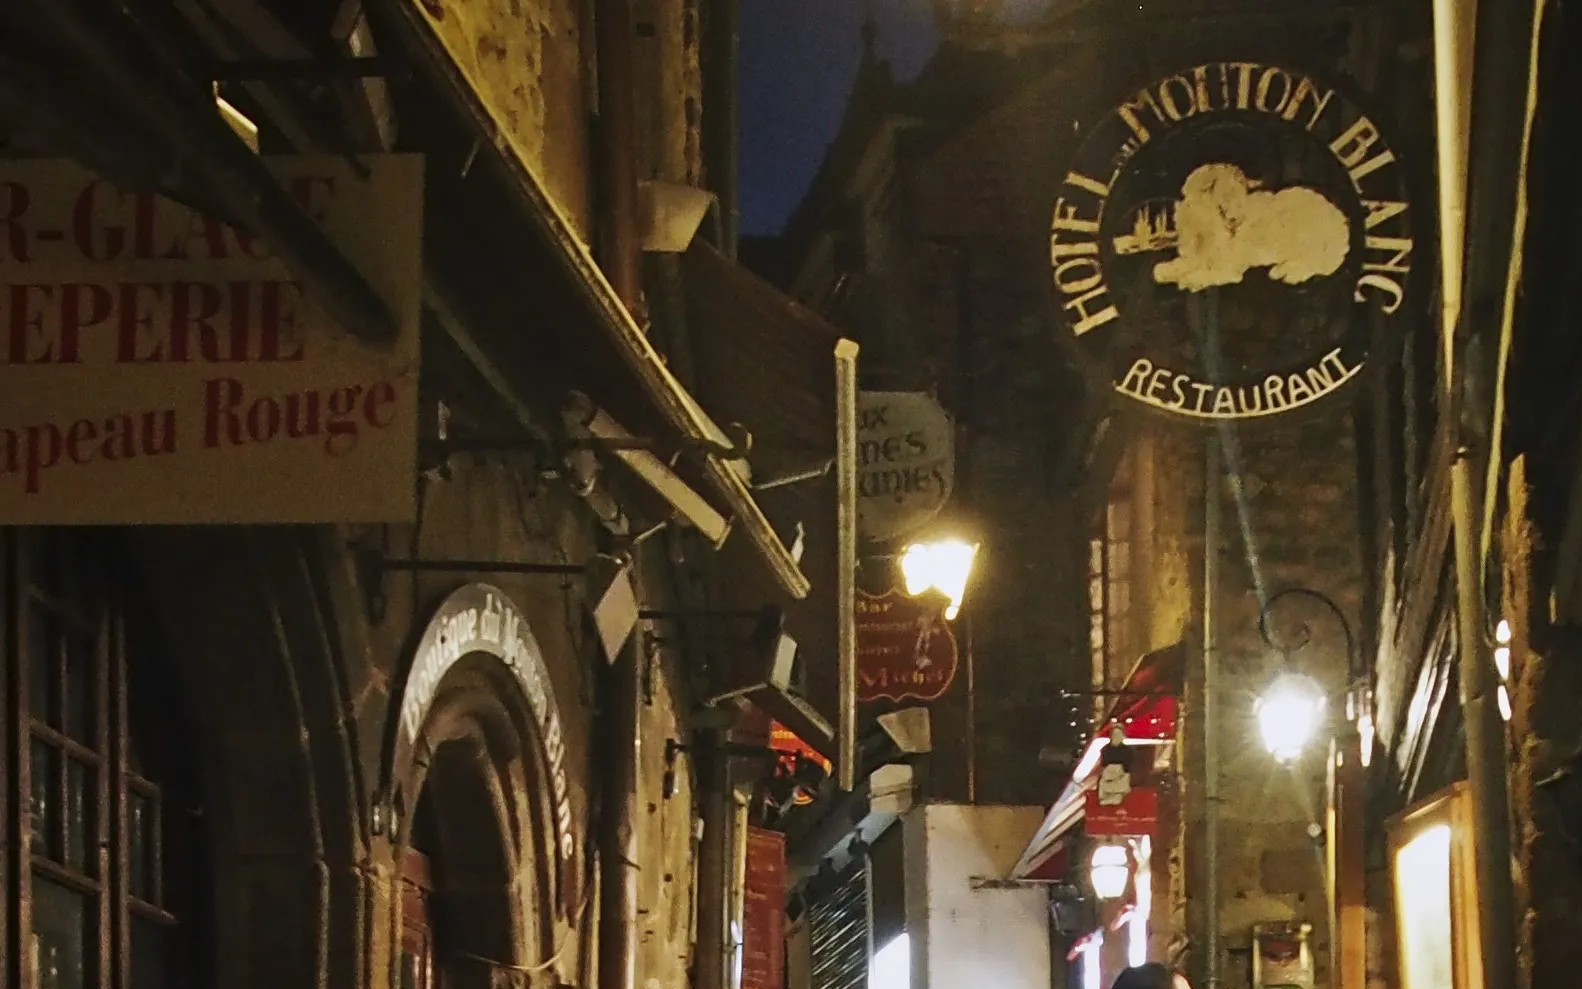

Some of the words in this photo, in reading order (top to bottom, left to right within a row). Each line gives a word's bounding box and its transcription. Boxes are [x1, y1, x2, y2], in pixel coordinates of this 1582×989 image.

[1050, 169, 1120, 337] HOTEL
[1118, 61, 1335, 143] MOUTON
[1328, 115, 1414, 315] BLANC
[202, 377, 398, 457] Rouge
[1116, 347, 1353, 414] RESTAURANT
